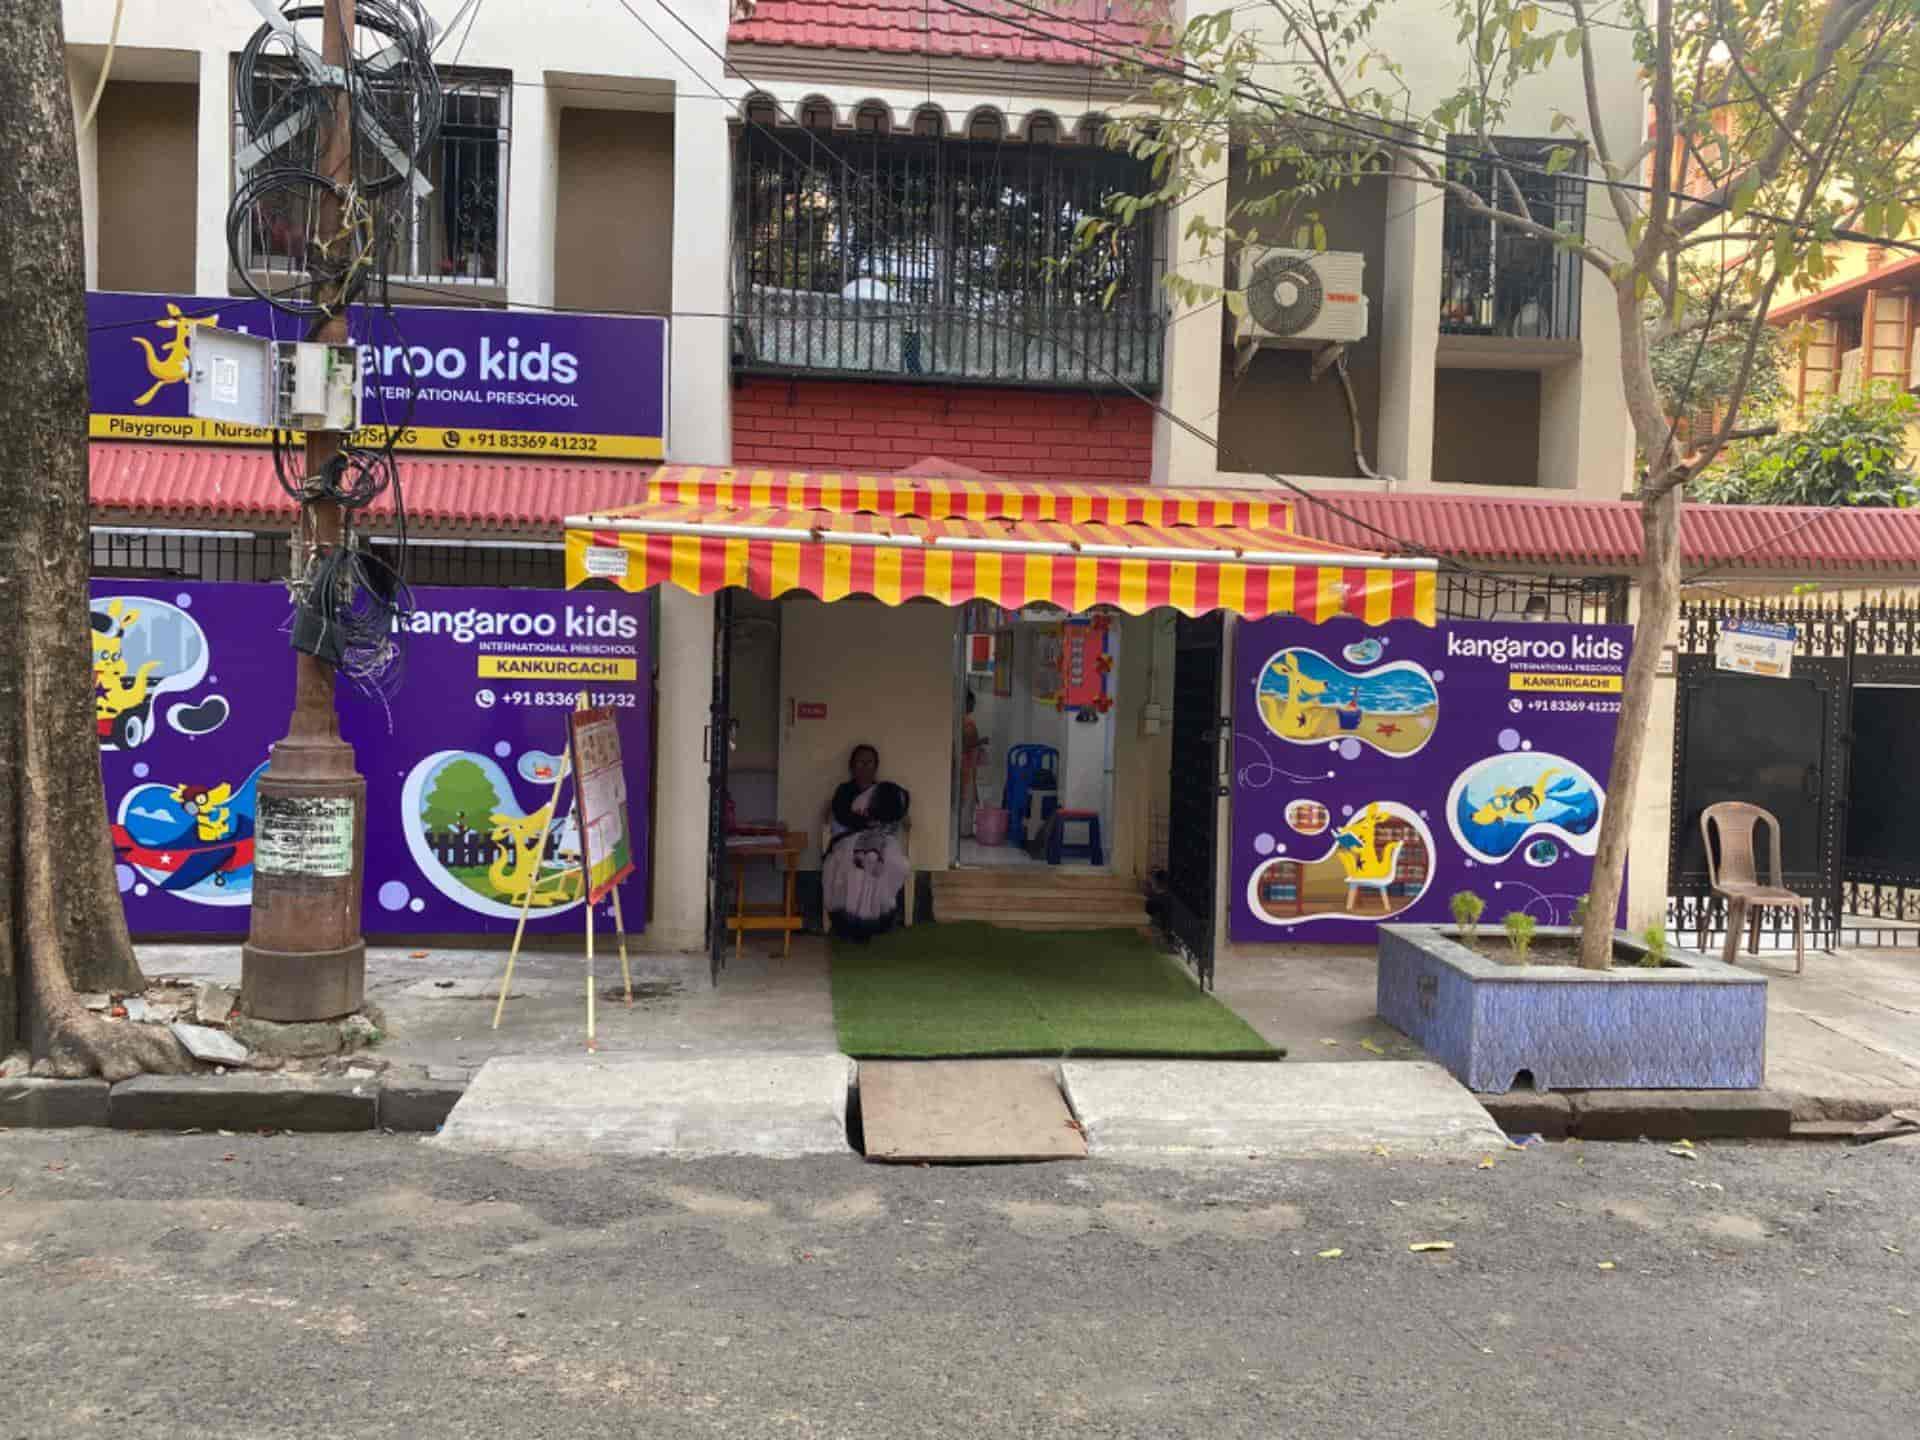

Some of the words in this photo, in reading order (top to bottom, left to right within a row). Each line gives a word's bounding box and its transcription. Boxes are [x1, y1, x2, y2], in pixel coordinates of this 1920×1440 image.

[479, 336, 579, 384] kids
[363, 386, 482, 403] NTERATIONAL
[487, 390, 578, 407] PRESCHOOL
[109, 418, 193, 437] Playgroup
[214, 422, 275, 438] Nurser
[469, 432, 496, 447] +91
[499, 433, 547, 449] 83369
[550, 436, 598, 451] 41232
[390, 606, 557, 643] kangaroo
[565, 605, 638, 639] kids
[479, 641, 568, 654] INTERNATIONAL
[570, 644, 638, 655] PRESCHOOL
[1448, 631, 1565, 664] kangaroo
[1571, 634, 1624, 660] kids
[497, 659, 619, 675] KANKURGACHI
[1523, 676, 1611, 689] KANKURGACHI
[502, 691, 531, 705] +91
[1527, 699, 1549, 711] +91
[1550, 700, 1585, 712] 83369
